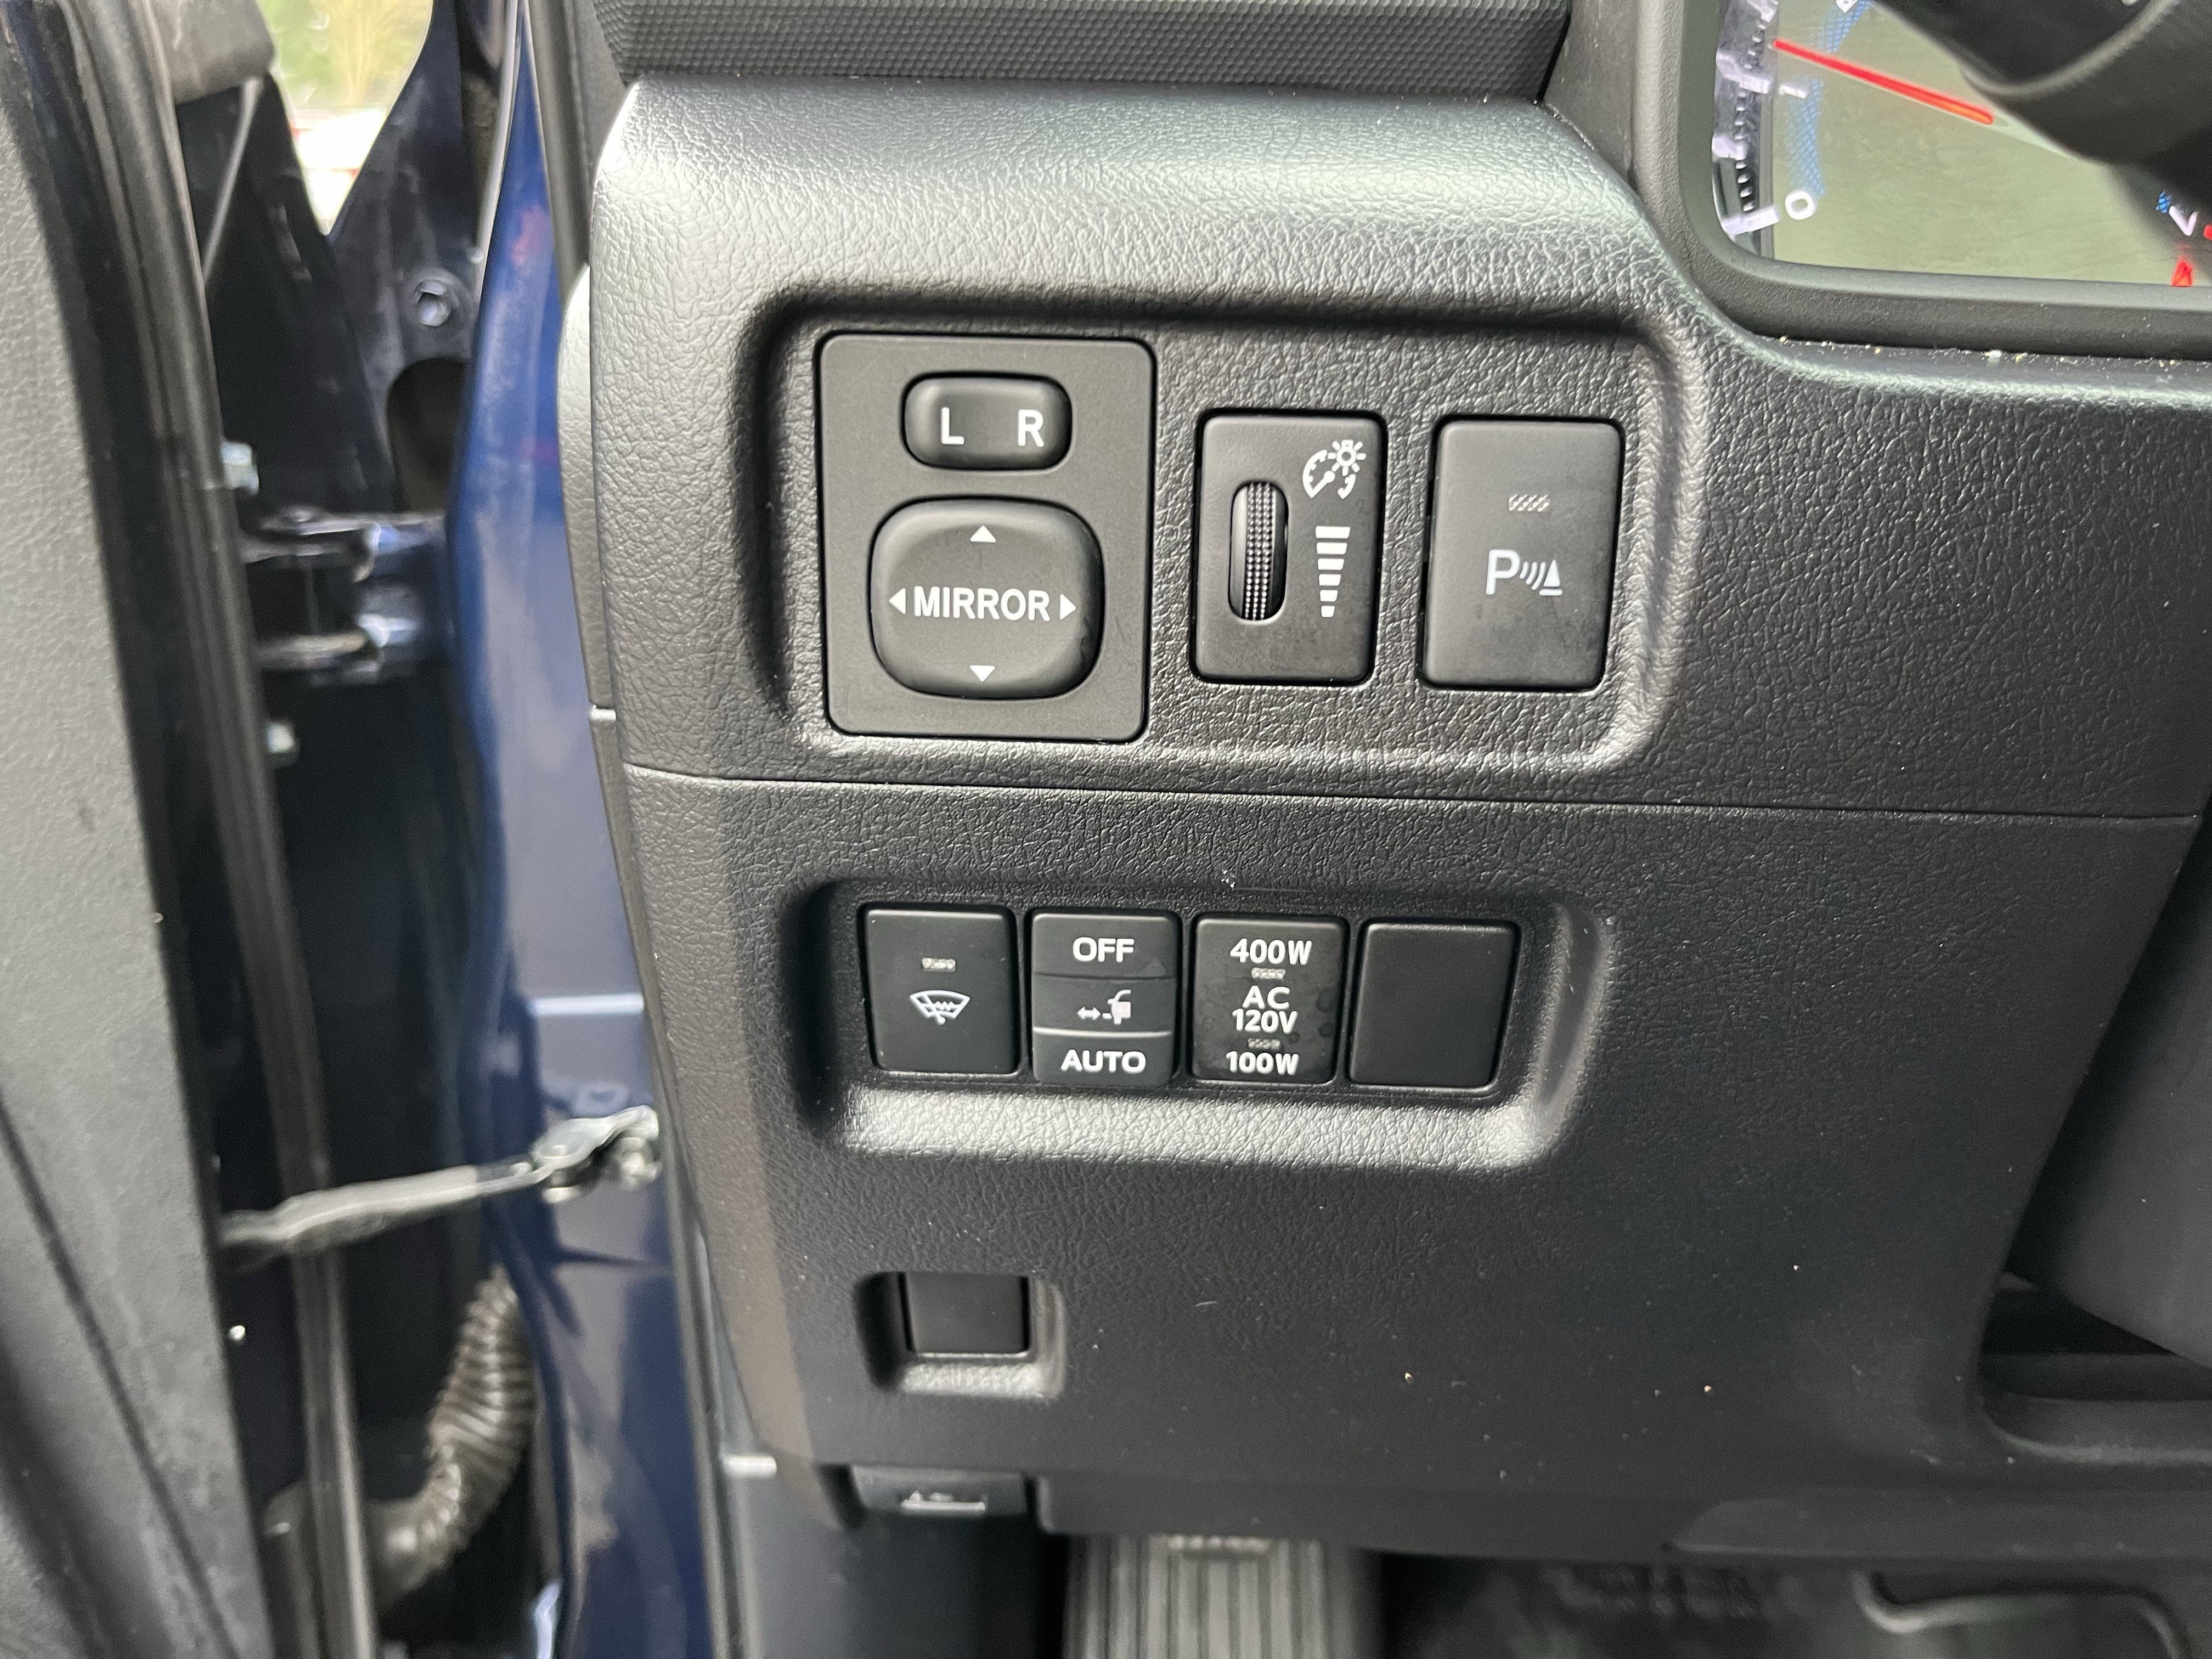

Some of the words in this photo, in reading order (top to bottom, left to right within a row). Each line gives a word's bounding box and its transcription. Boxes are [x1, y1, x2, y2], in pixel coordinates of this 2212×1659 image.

[1785, 189, 1817, 220] 0
[941, 407, 964, 445] L
[1018, 409, 1045, 448] R
[1485, 549, 1519, 595] P
[913, 585, 1051, 622] MIRROR
[1073, 936, 1135, 963] OFF
[1229, 938, 1312, 965] 400W
[1242, 985, 1290, 1009] AC
[1232, 1008, 1298, 1034] 120V
[1060, 1049, 1146, 1074] AUTO
[1226, 1051, 1299, 1075] 100W
